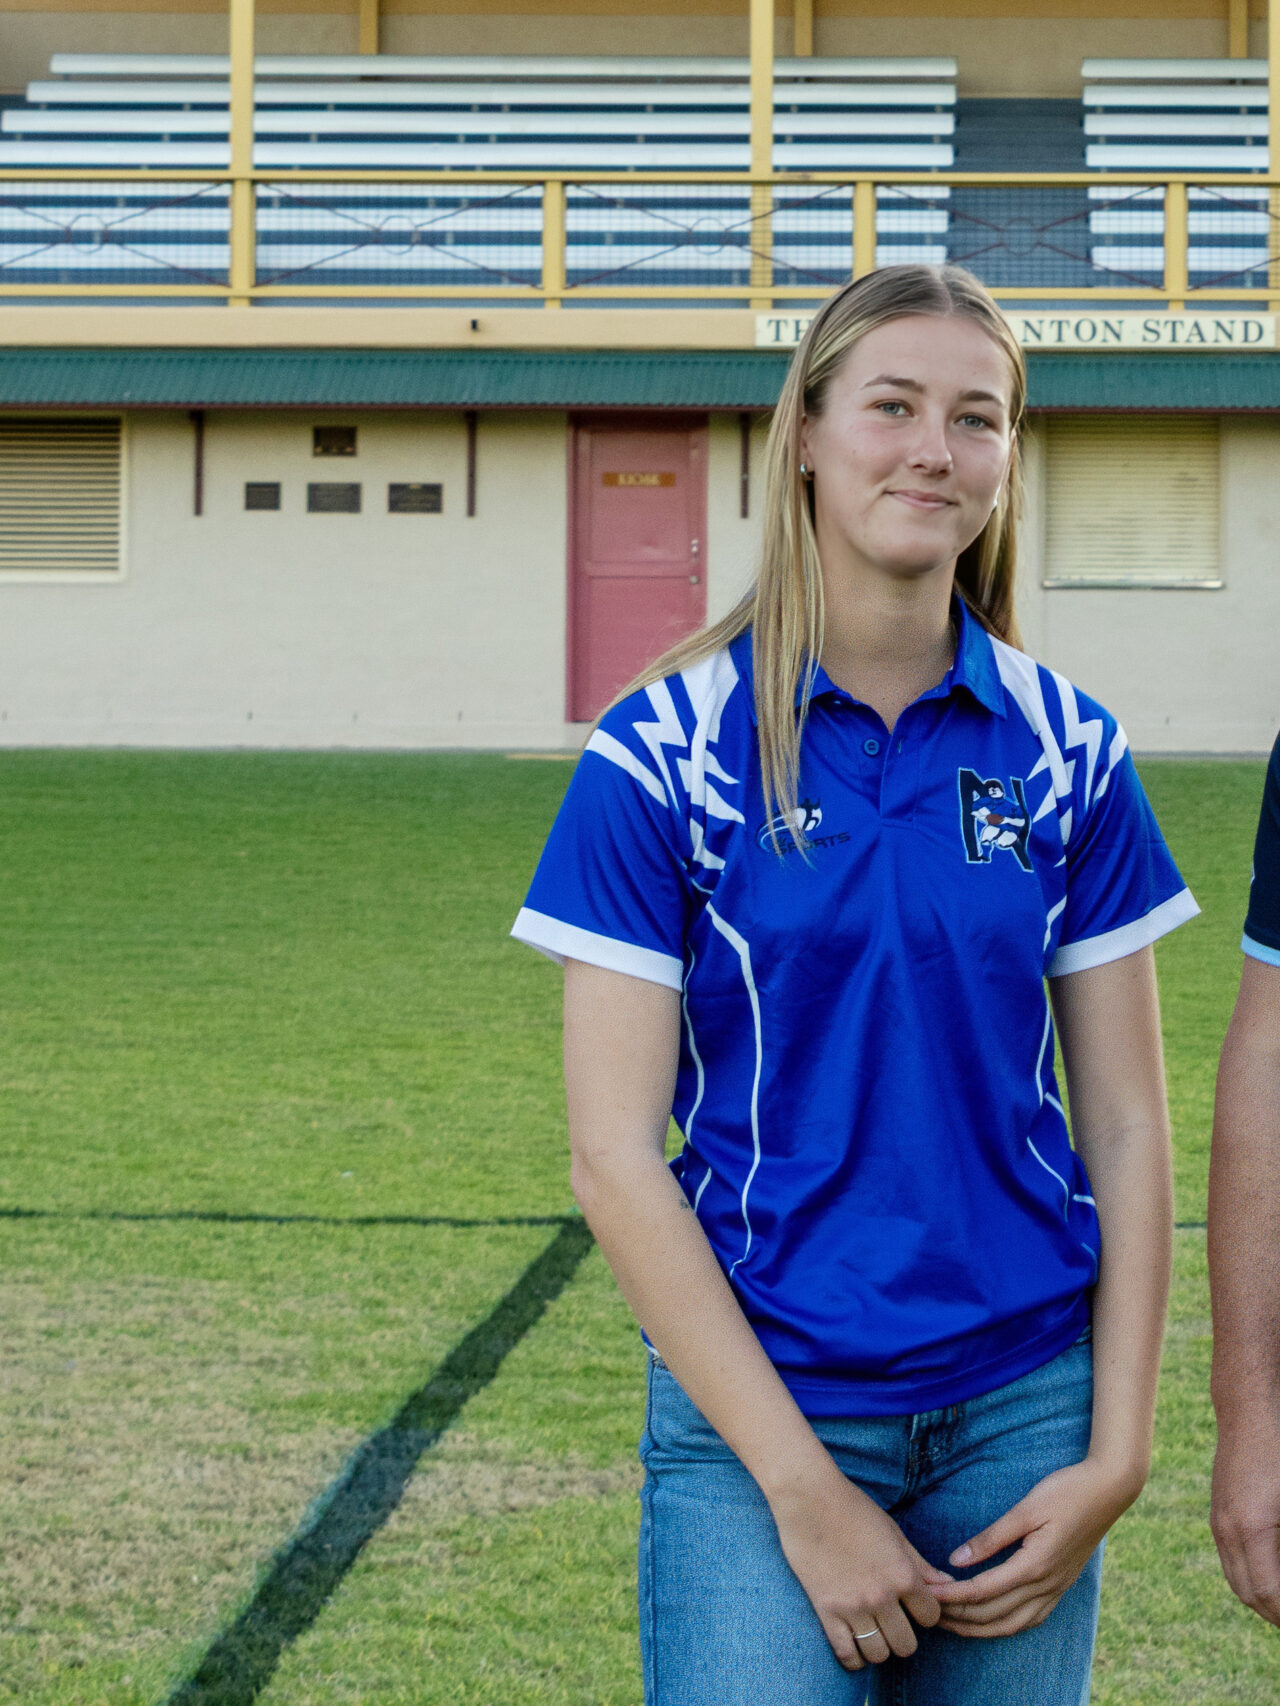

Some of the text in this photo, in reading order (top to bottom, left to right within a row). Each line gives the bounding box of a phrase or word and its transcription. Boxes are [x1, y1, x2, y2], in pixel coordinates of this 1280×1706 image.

[767, 318, 1264, 342] TH NTON STAND
